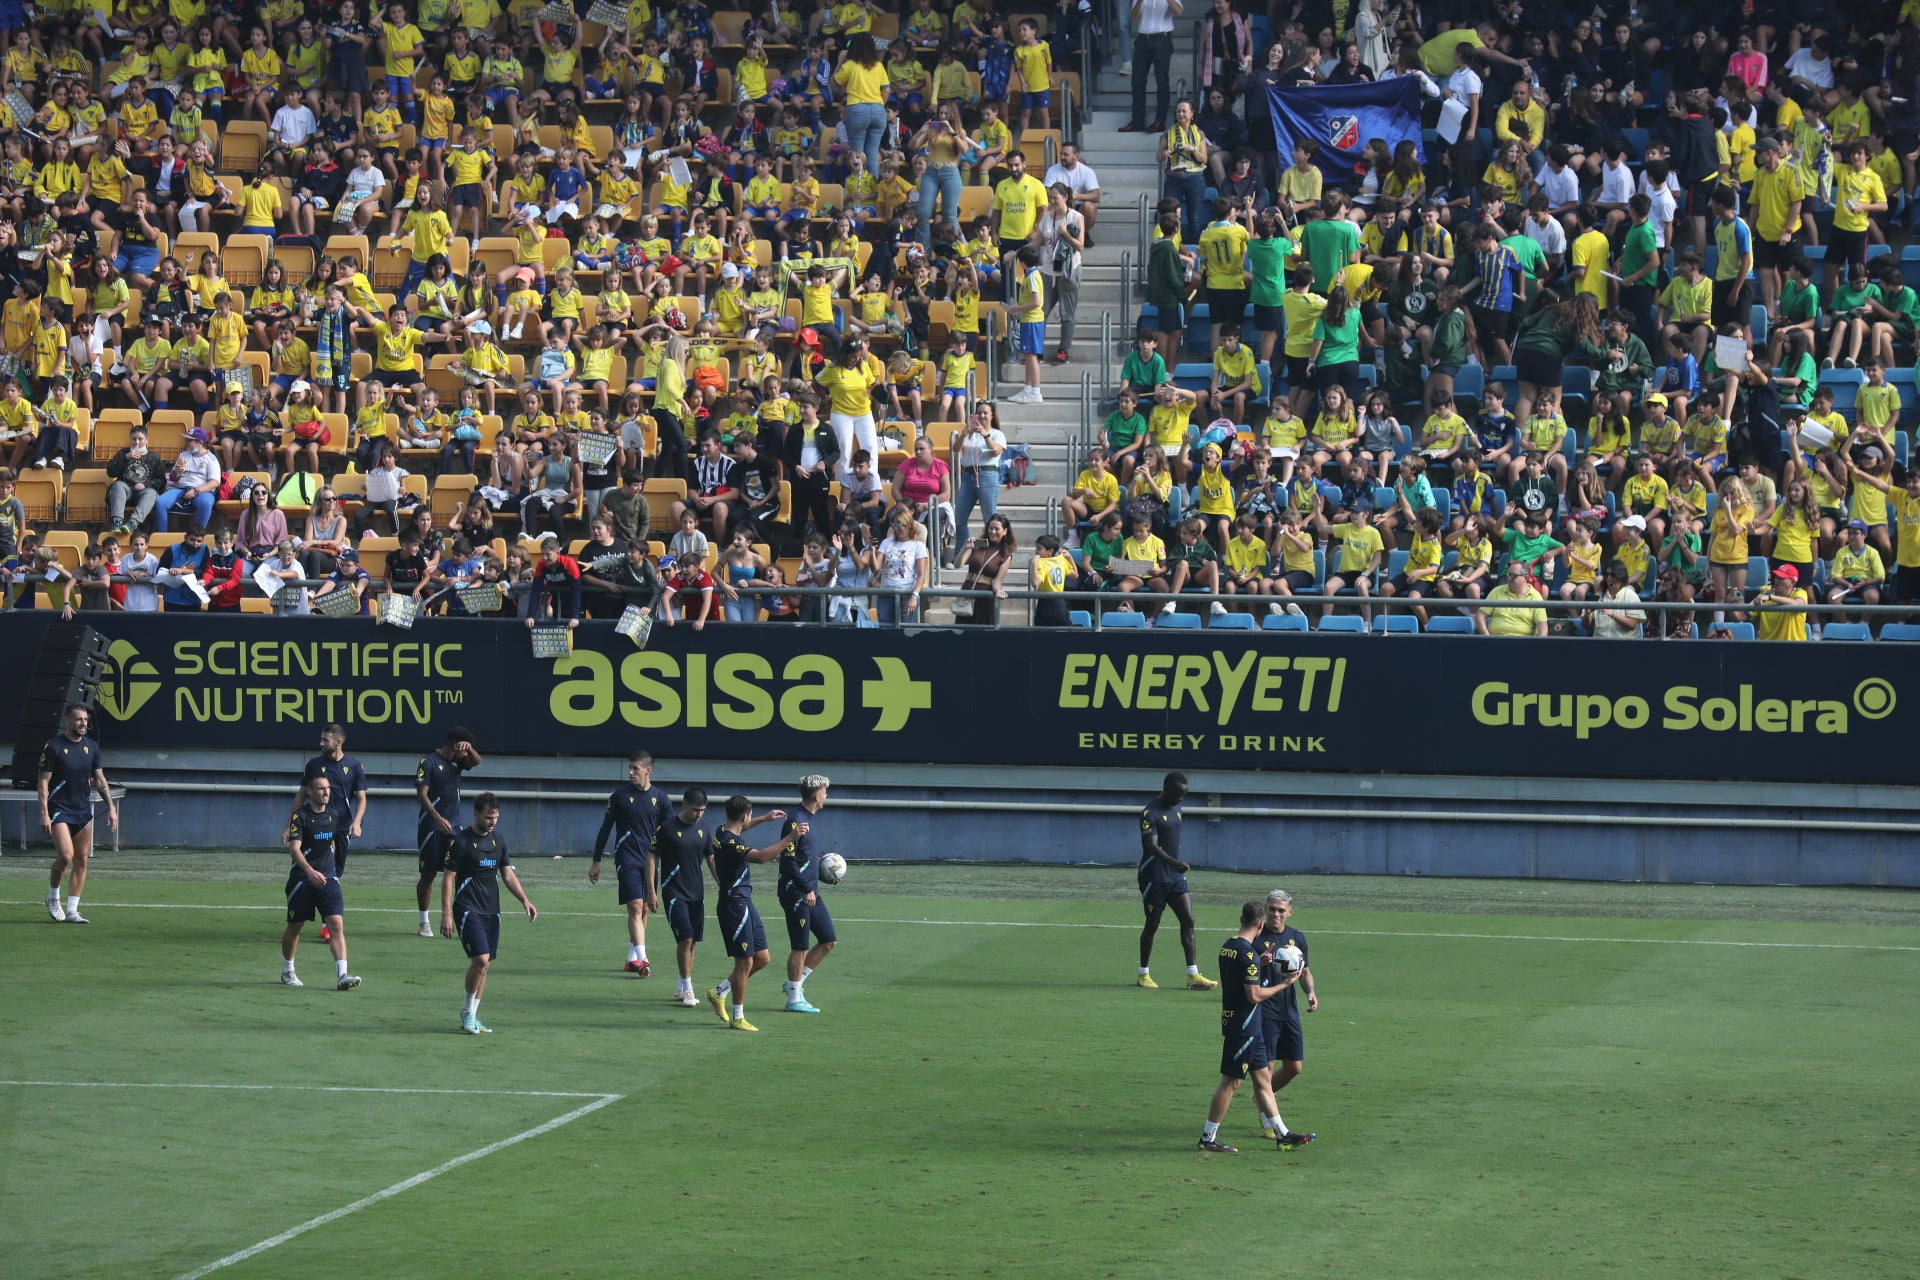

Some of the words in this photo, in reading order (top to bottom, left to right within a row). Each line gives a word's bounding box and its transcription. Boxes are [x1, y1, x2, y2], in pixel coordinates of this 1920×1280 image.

[1211, 240, 1232, 264] 11
[337, 374, 346, 384] 15
[174, 641, 463, 677] SCIENTIFFIC
[549, 651, 845, 732] asisa
[1059, 651, 1347, 726] ENERYETI
[1472, 681, 1650, 739] Grupo
[1663, 685, 1849, 734] Solera
[1079, 732, 1204, 751] ENERGY
[1219, 735, 1326, 753] DRINK
